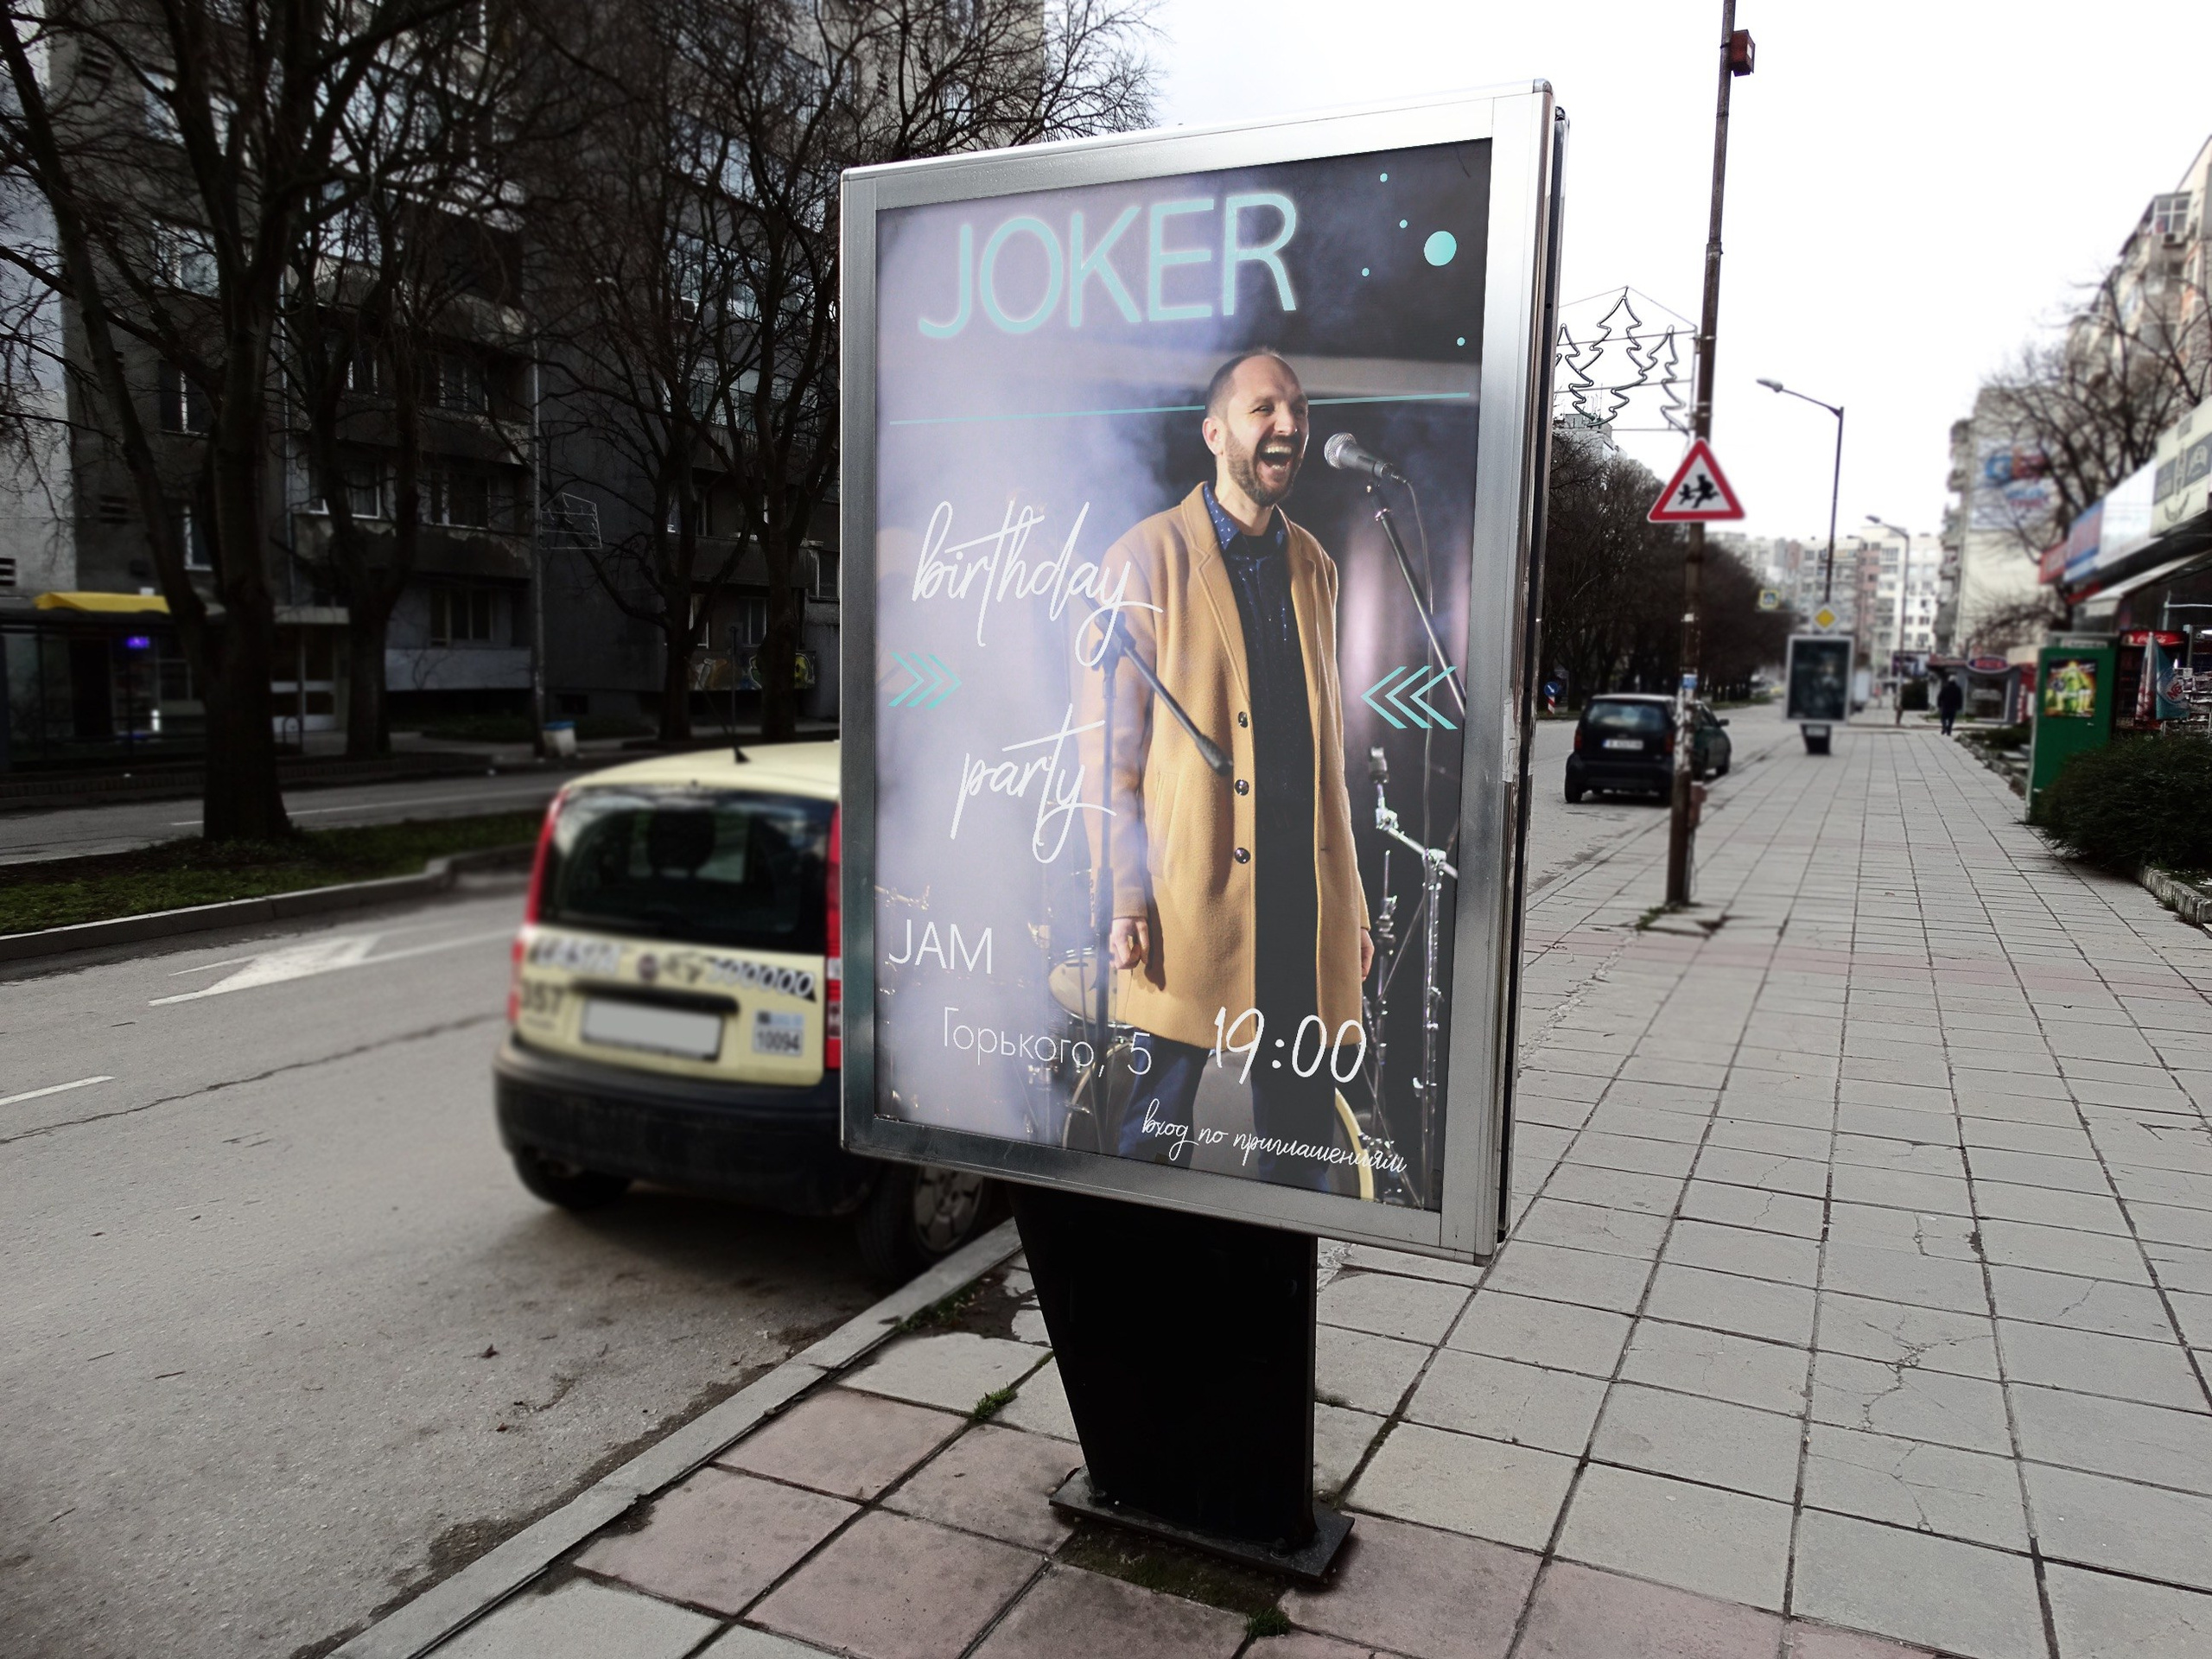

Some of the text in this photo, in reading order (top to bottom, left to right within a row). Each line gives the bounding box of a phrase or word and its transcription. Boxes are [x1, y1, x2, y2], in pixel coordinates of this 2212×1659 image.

[918, 193, 1297, 339] JOKER
[911, 500, 1164, 667] birthday
[950, 702, 1117, 863] party
[888, 918, 993, 975] JAM
[944, 1007, 1153, 1077] Горького, 5
[1212, 1007, 1368, 1085] 19:00
[1141, 1098, 1408, 1173] вход по приглашениям
